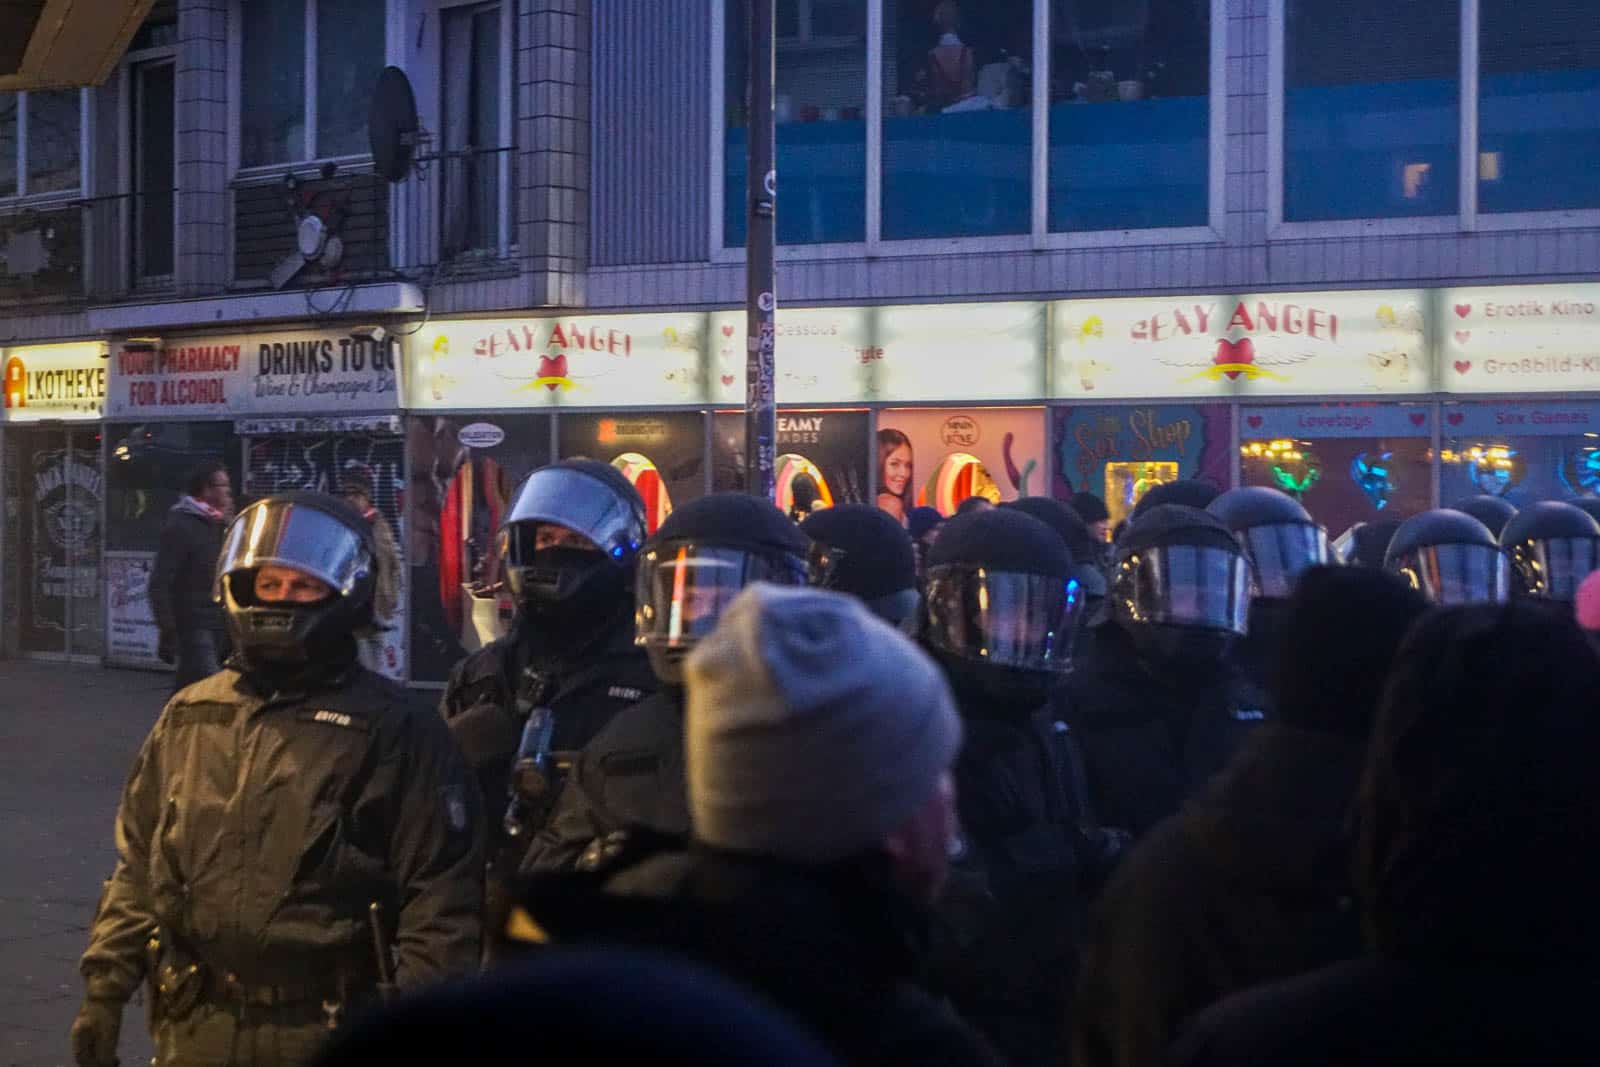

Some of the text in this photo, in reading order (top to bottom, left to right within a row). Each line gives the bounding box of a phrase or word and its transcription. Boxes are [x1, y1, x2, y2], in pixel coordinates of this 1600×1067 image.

[1485, 299, 1595, 317] Erotik Kino
[159, 345, 241, 373] PHARMACY
[259, 339, 333, 375] DRINKS
[339, 338, 364, 371] TO
[4, 356, 105, 408] ALKOTHEKE
[130, 378, 227, 406] FOR ALCOHOL
[776, 417, 823, 432] EAMY
[1496, 411, 1525, 425] Sex
[777, 433, 818, 444] ADES
